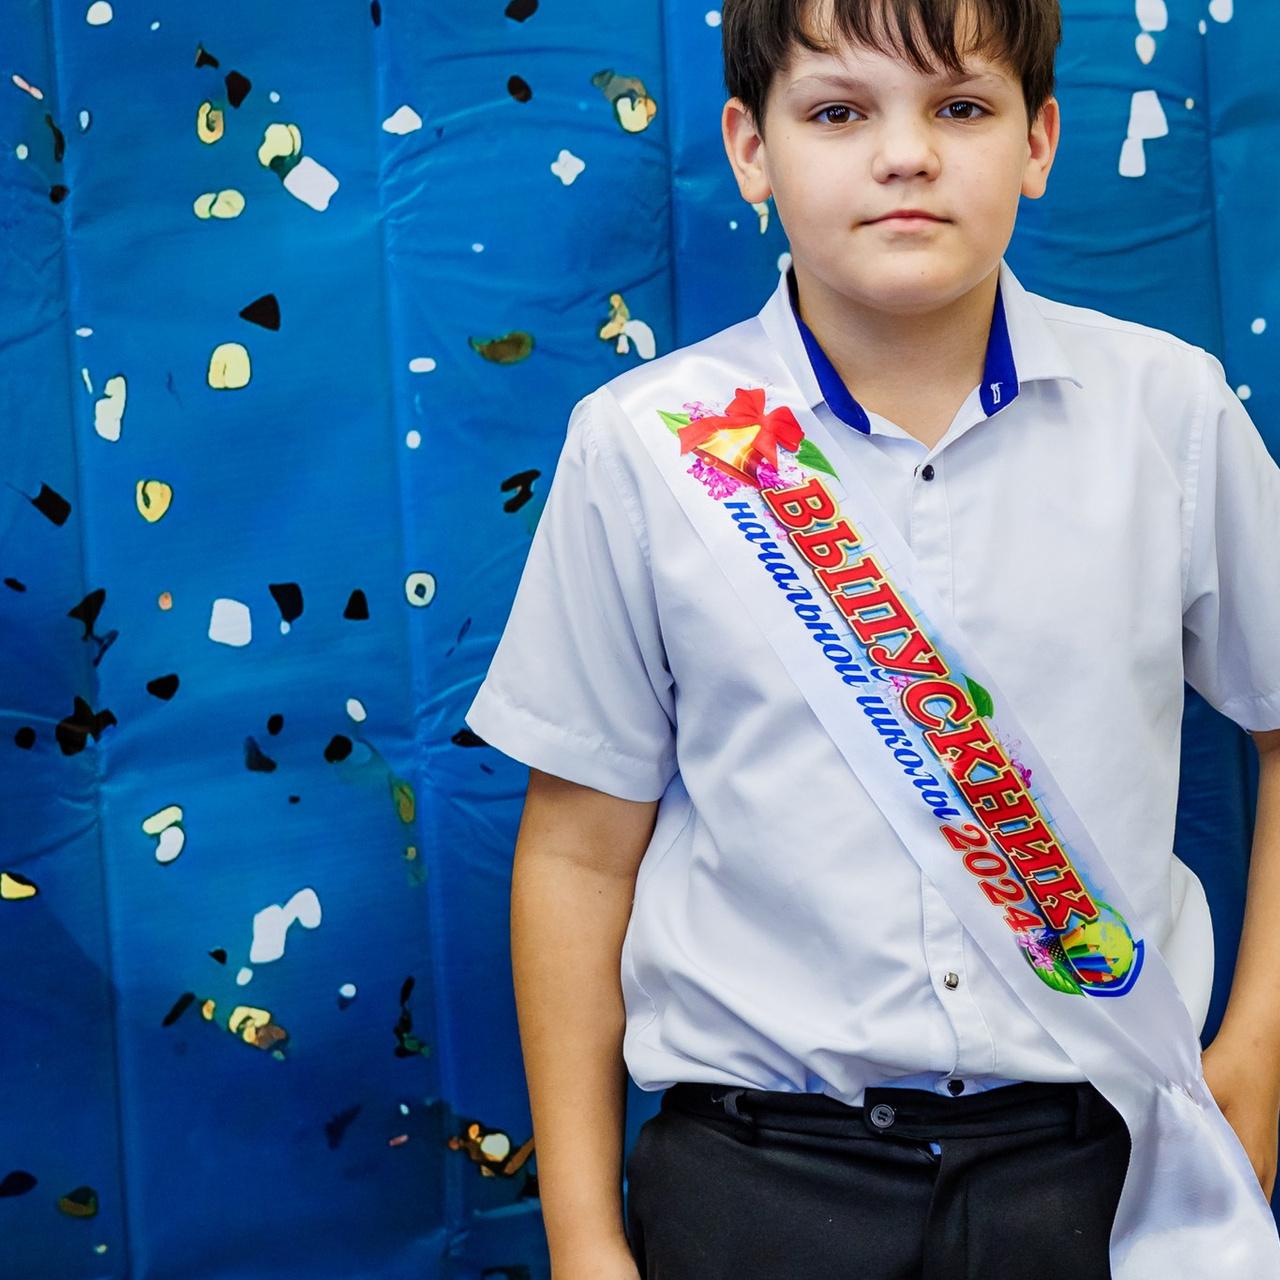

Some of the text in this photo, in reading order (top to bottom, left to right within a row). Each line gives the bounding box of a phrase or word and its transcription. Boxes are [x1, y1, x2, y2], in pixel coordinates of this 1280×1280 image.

[724, 501, 1046, 932] начальной школы 2024
[760, 476, 1101, 931] ВЫПУСКНИК
